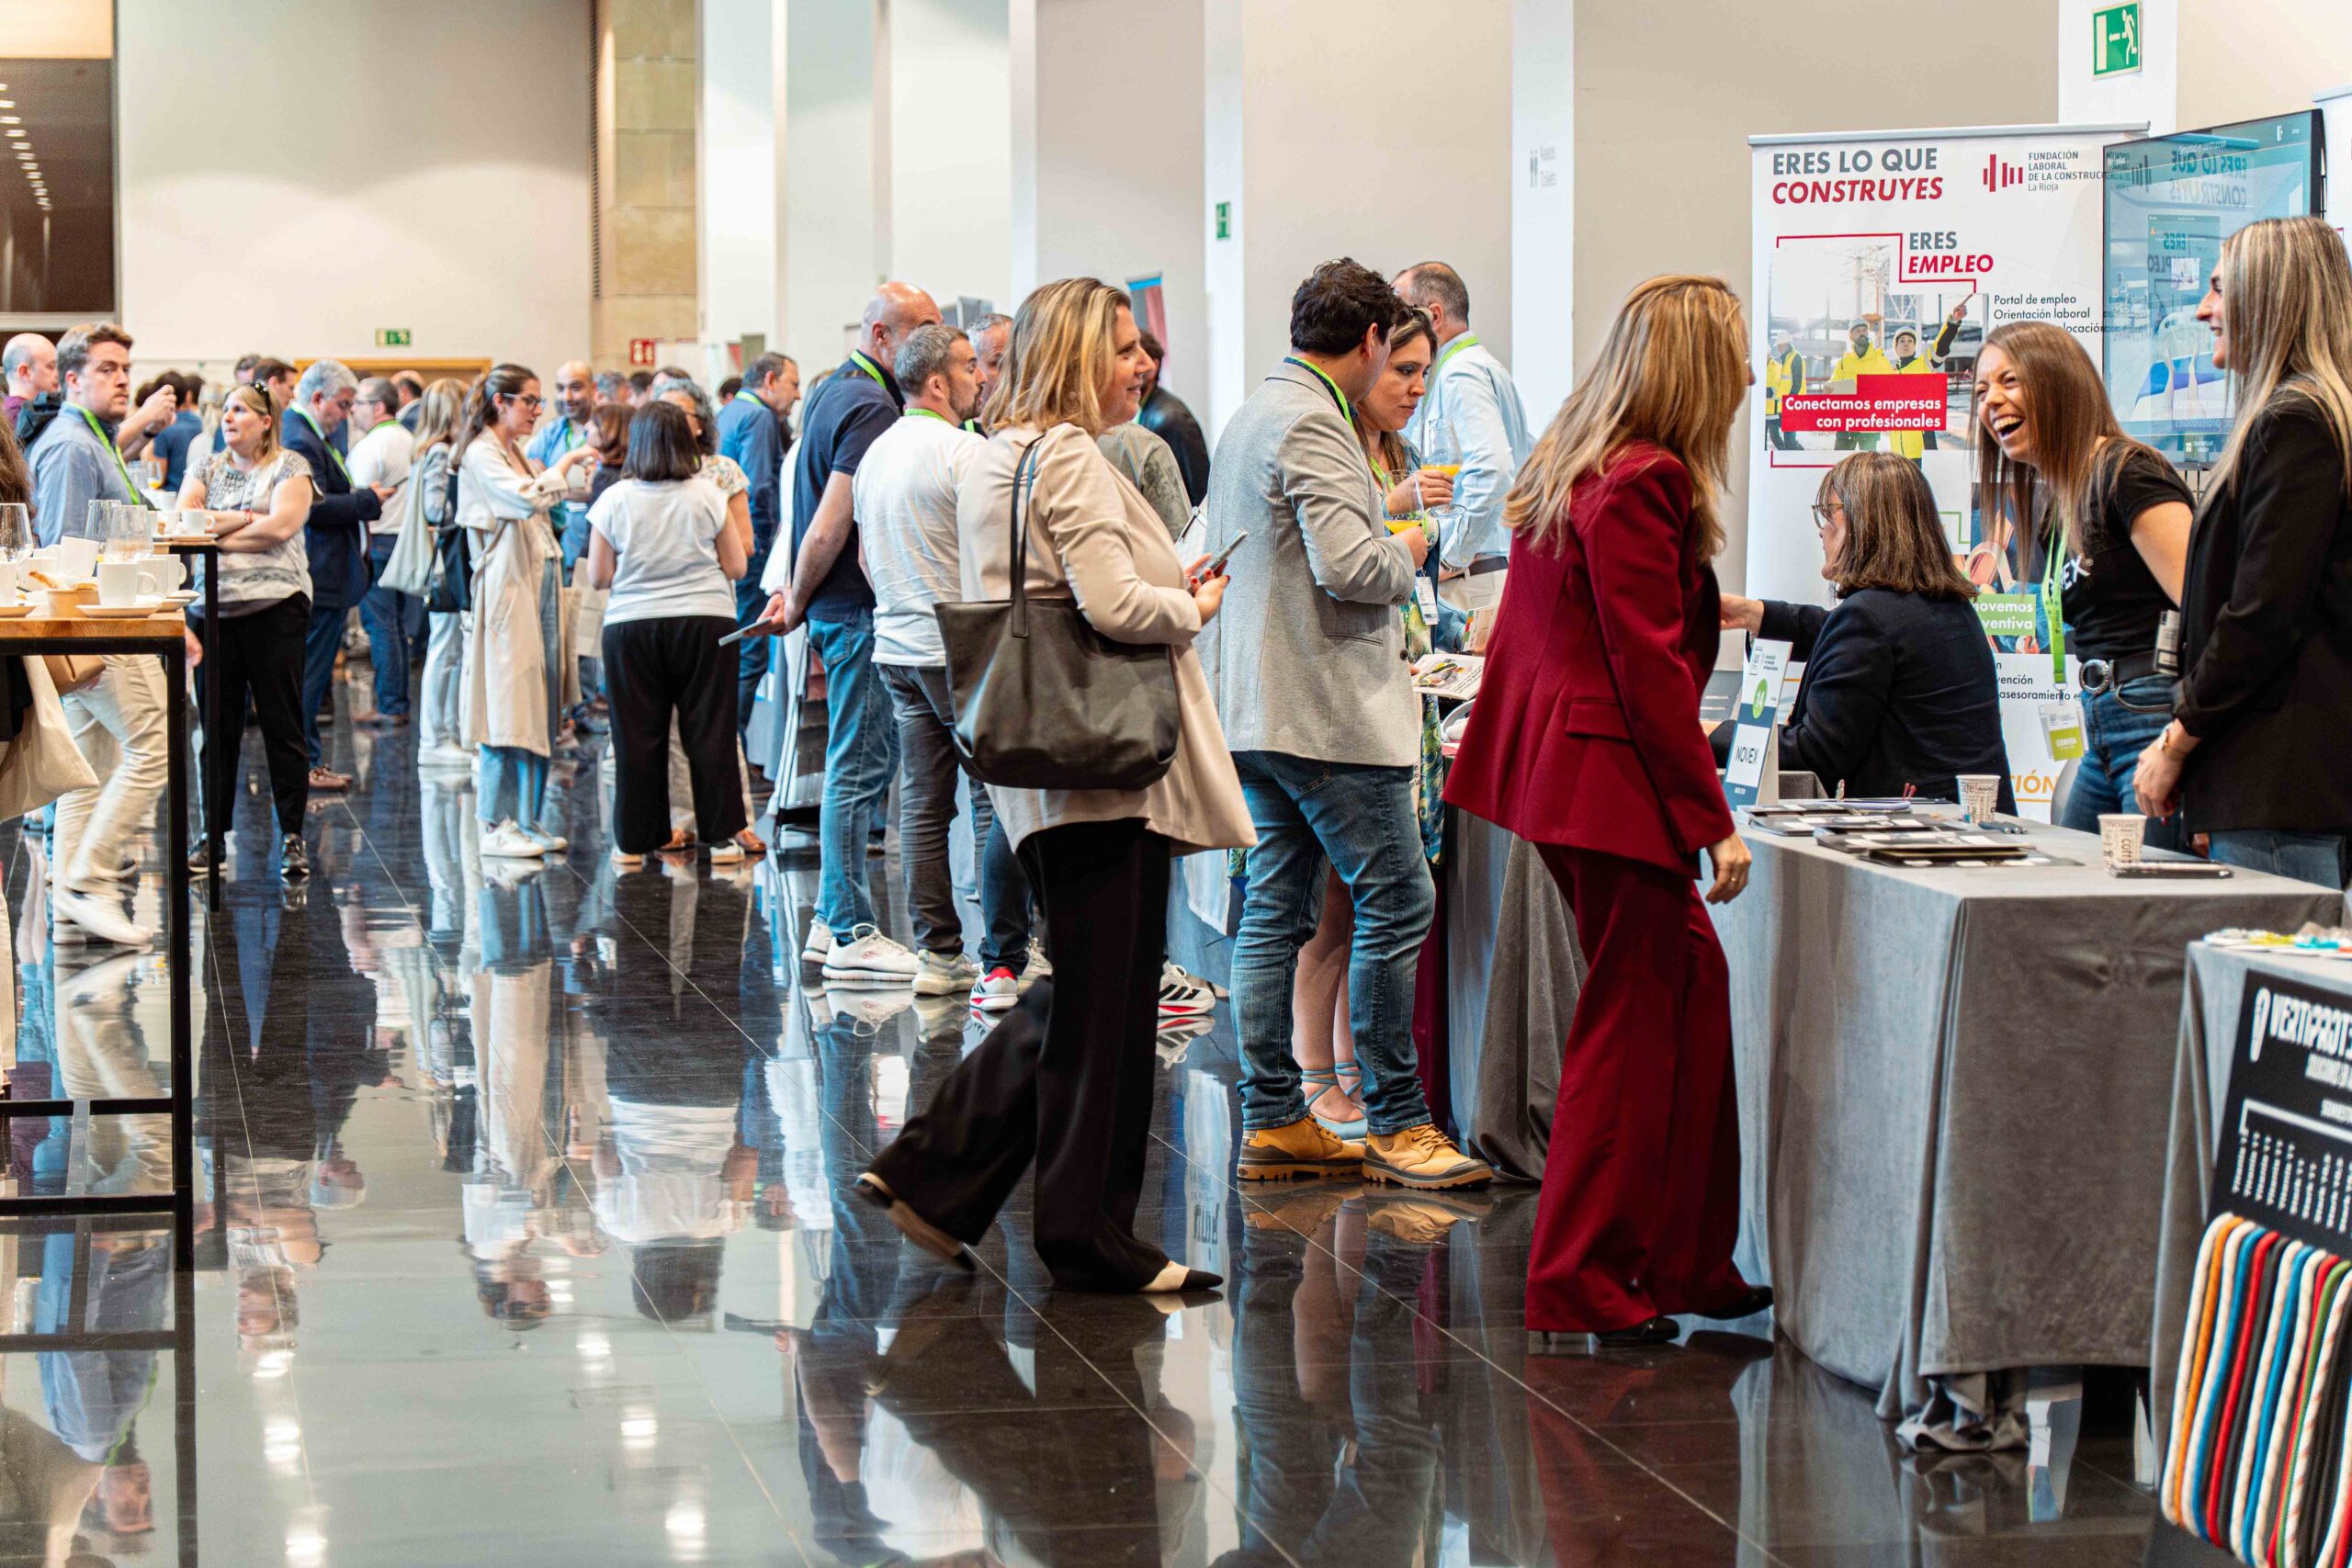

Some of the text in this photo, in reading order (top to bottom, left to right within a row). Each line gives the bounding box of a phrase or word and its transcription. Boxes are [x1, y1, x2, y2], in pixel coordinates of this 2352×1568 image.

[1773, 148, 1938, 175] ERES LO QUE
[2029, 149, 2079, 161] FUNDACIÓN
[2029, 162, 2067, 171] LABORAL
[2029, 173, 2039, 181] DE
[2041, 173, 2052, 181] LA
[1772, 176, 1943, 204] CONSTRUYES
[2039, 182, 2059, 192] Rioja
[1909, 231, 1957, 250] ERES
[1908, 254, 1994, 274] EMPLEO
[1994, 293, 2076, 307] Portal de empleo
[1994, 306, 2090, 320] Orientación laboral
[1785, 397, 1941, 413] Conectamos empresas
[1816, 413, 1941, 431] con profesionales
[1735, 746, 1759, 765] NOVEX
[2010, 769, 2058, 794] IÓN
